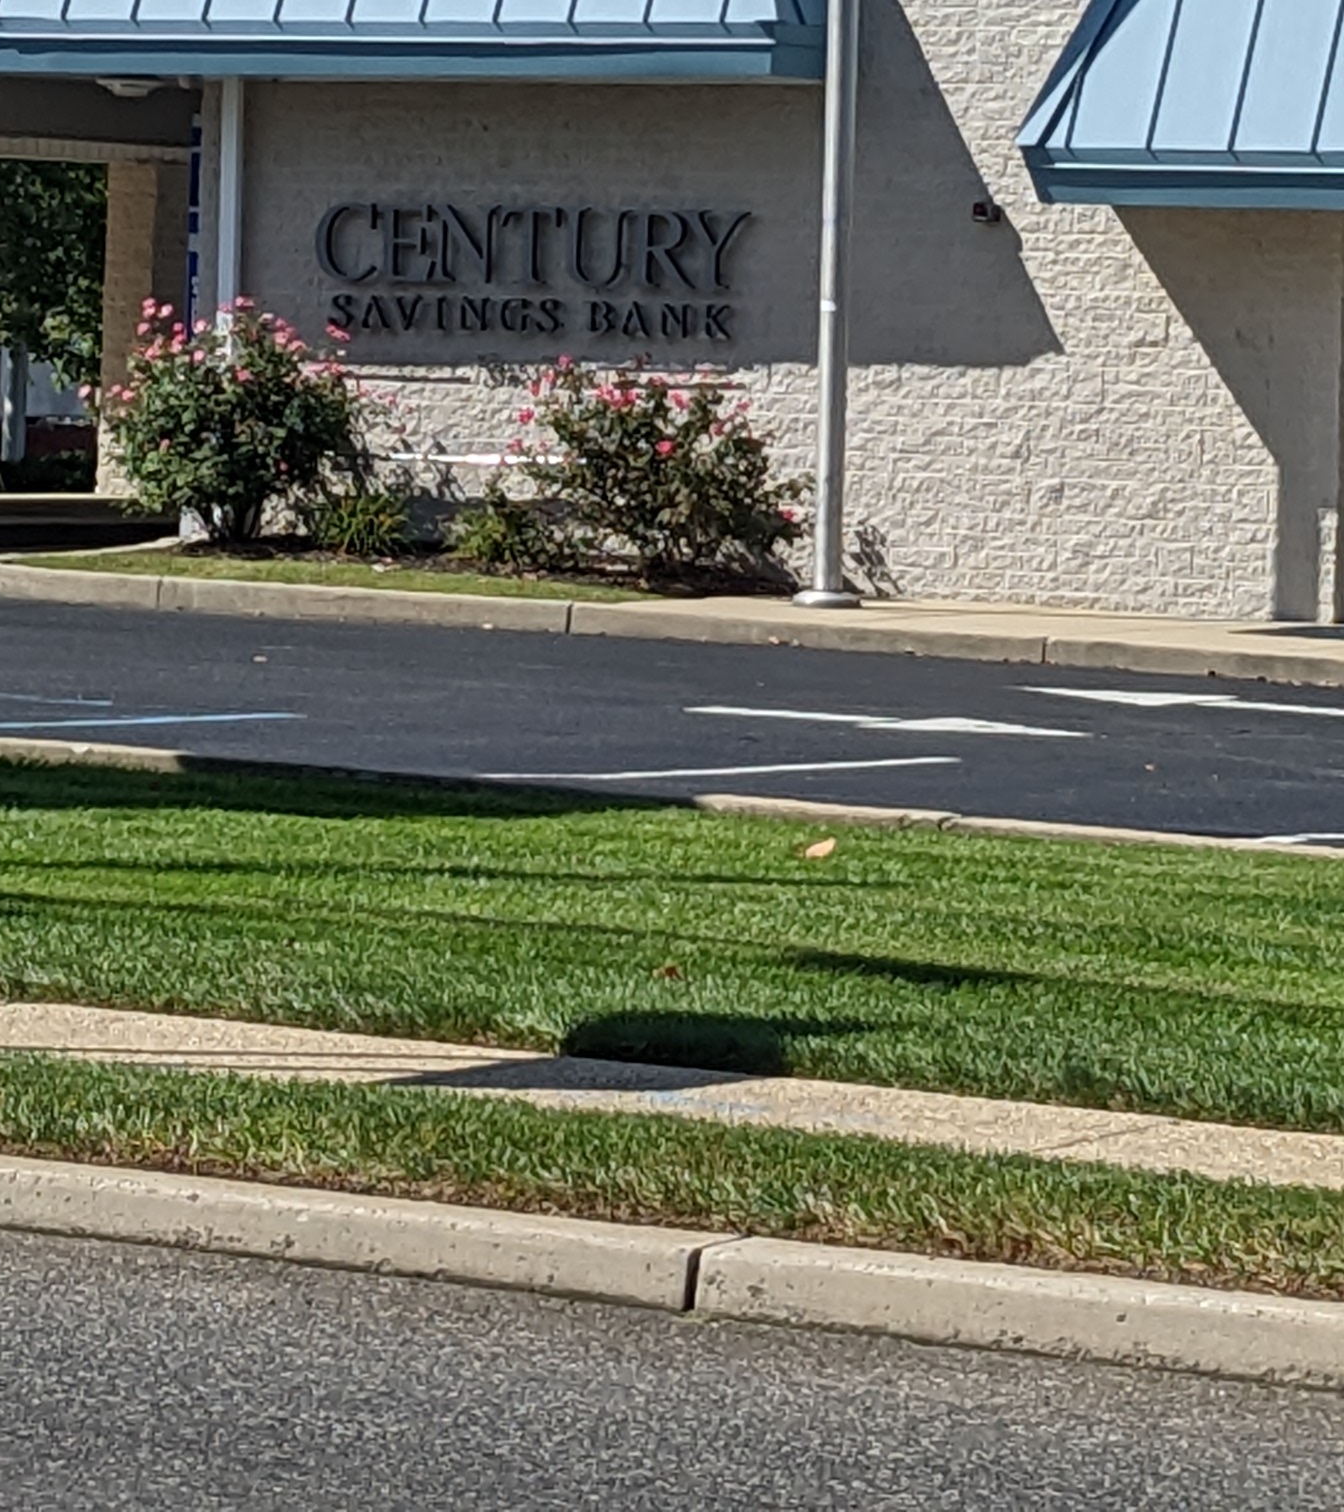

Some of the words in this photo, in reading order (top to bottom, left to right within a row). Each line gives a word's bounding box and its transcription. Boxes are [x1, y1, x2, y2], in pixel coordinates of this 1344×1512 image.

[314, 201, 754, 290] CENTURY
[327, 292, 565, 335] SAVINGS
[588, 299, 733, 340] BANK
